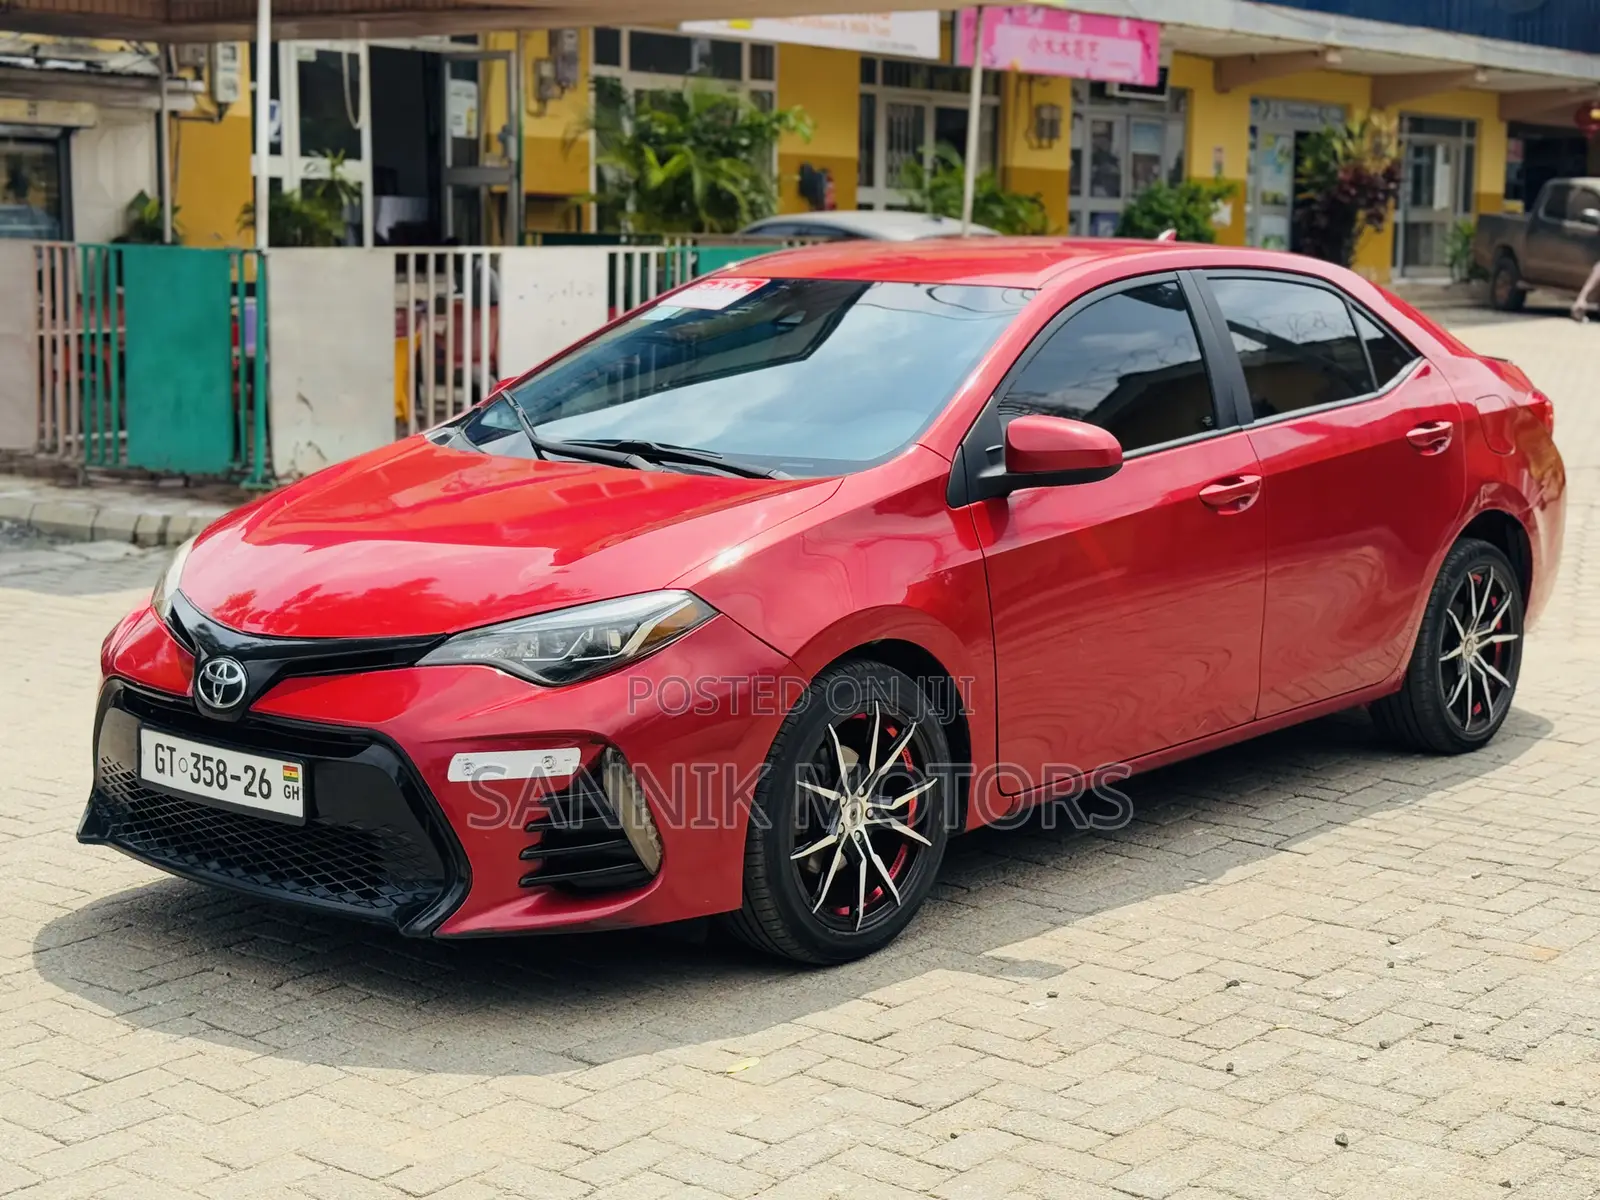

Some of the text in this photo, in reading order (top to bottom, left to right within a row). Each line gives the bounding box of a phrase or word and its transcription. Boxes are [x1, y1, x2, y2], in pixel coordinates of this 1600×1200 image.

[154, 742, 273, 800] GT 358-26
[283, 784, 300, 801] GH
